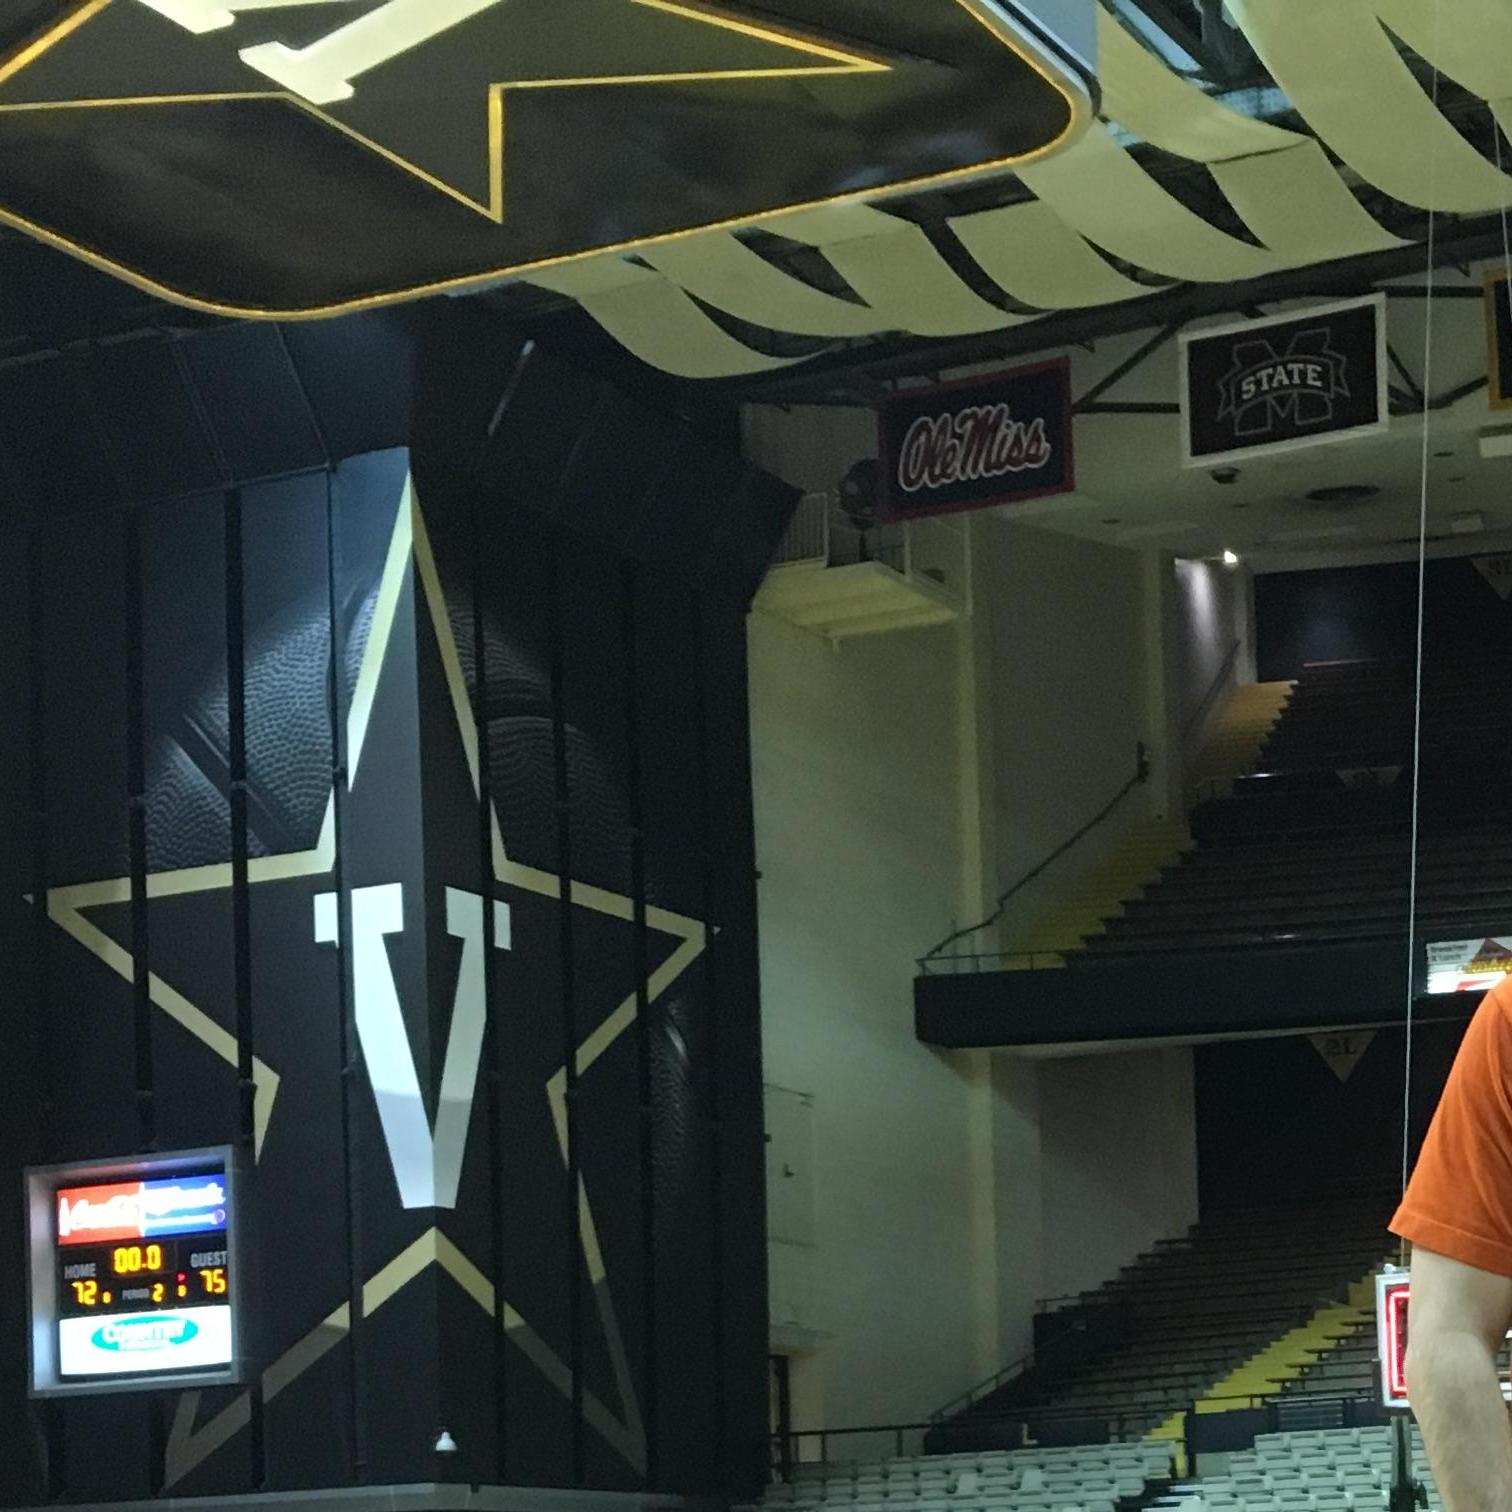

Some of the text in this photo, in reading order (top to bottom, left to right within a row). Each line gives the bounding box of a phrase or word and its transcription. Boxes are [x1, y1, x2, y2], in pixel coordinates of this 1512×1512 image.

[1241, 363, 1323, 400] STATE
[899, 402, 1051, 492] Ole Miss
[312, 881, 512, 1210] V
[64, 1251, 228, 1279] HOME GUEST
[114, 1245, 161, 1273] 00.0
[72, 1281, 97, 1305] 72
[153, 1283, 164, 1302] 2
[200, 1269, 226, 1293] 75
